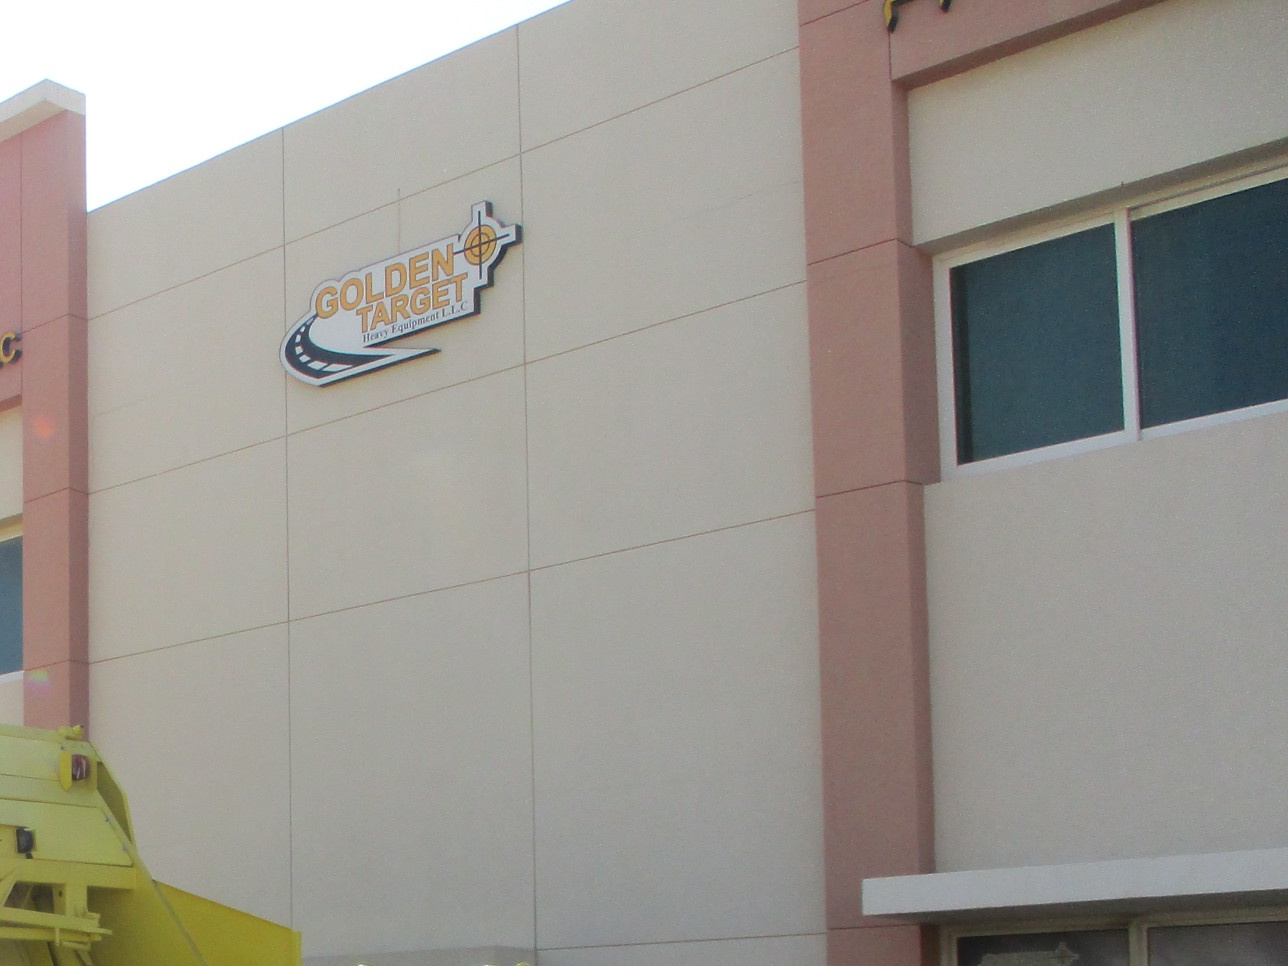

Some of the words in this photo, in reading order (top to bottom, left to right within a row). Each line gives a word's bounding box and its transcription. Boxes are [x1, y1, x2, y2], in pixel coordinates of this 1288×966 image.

[315, 243, 455, 319] GOLDEN
[356, 273, 469, 334] TARGET
[363, 328, 388, 343] Heavy
[392, 310, 439, 333] Equipment
